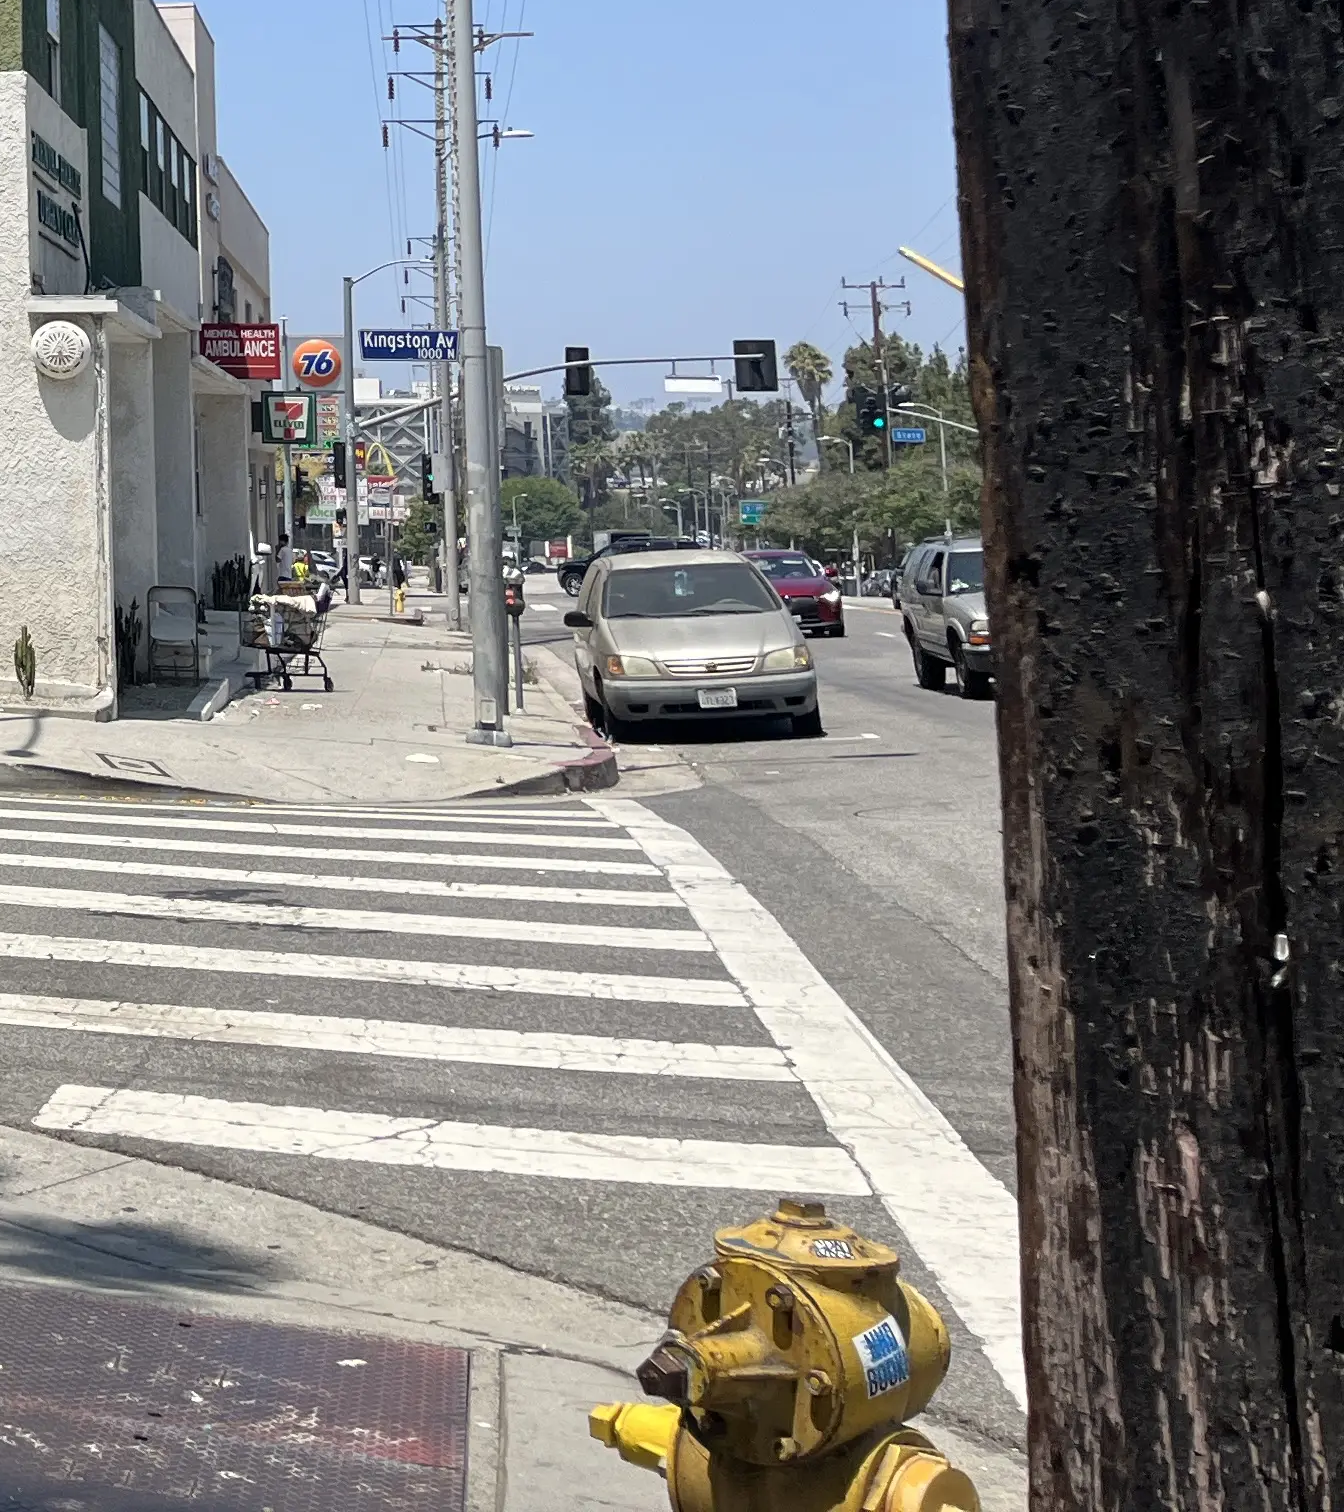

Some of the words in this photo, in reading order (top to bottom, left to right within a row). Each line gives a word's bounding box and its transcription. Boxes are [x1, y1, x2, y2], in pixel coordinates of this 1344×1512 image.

[204, 329, 238, 338] MENTAL
[240, 329, 275, 338] HEALTH
[363, 331, 430, 352] Kingston
[435, 332, 454, 348] Av
[205, 340, 275, 357] AMBULANCE
[417, 348, 442, 359] 1000
[447, 348, 455, 359] N
[300, 349, 334, 377] 76
